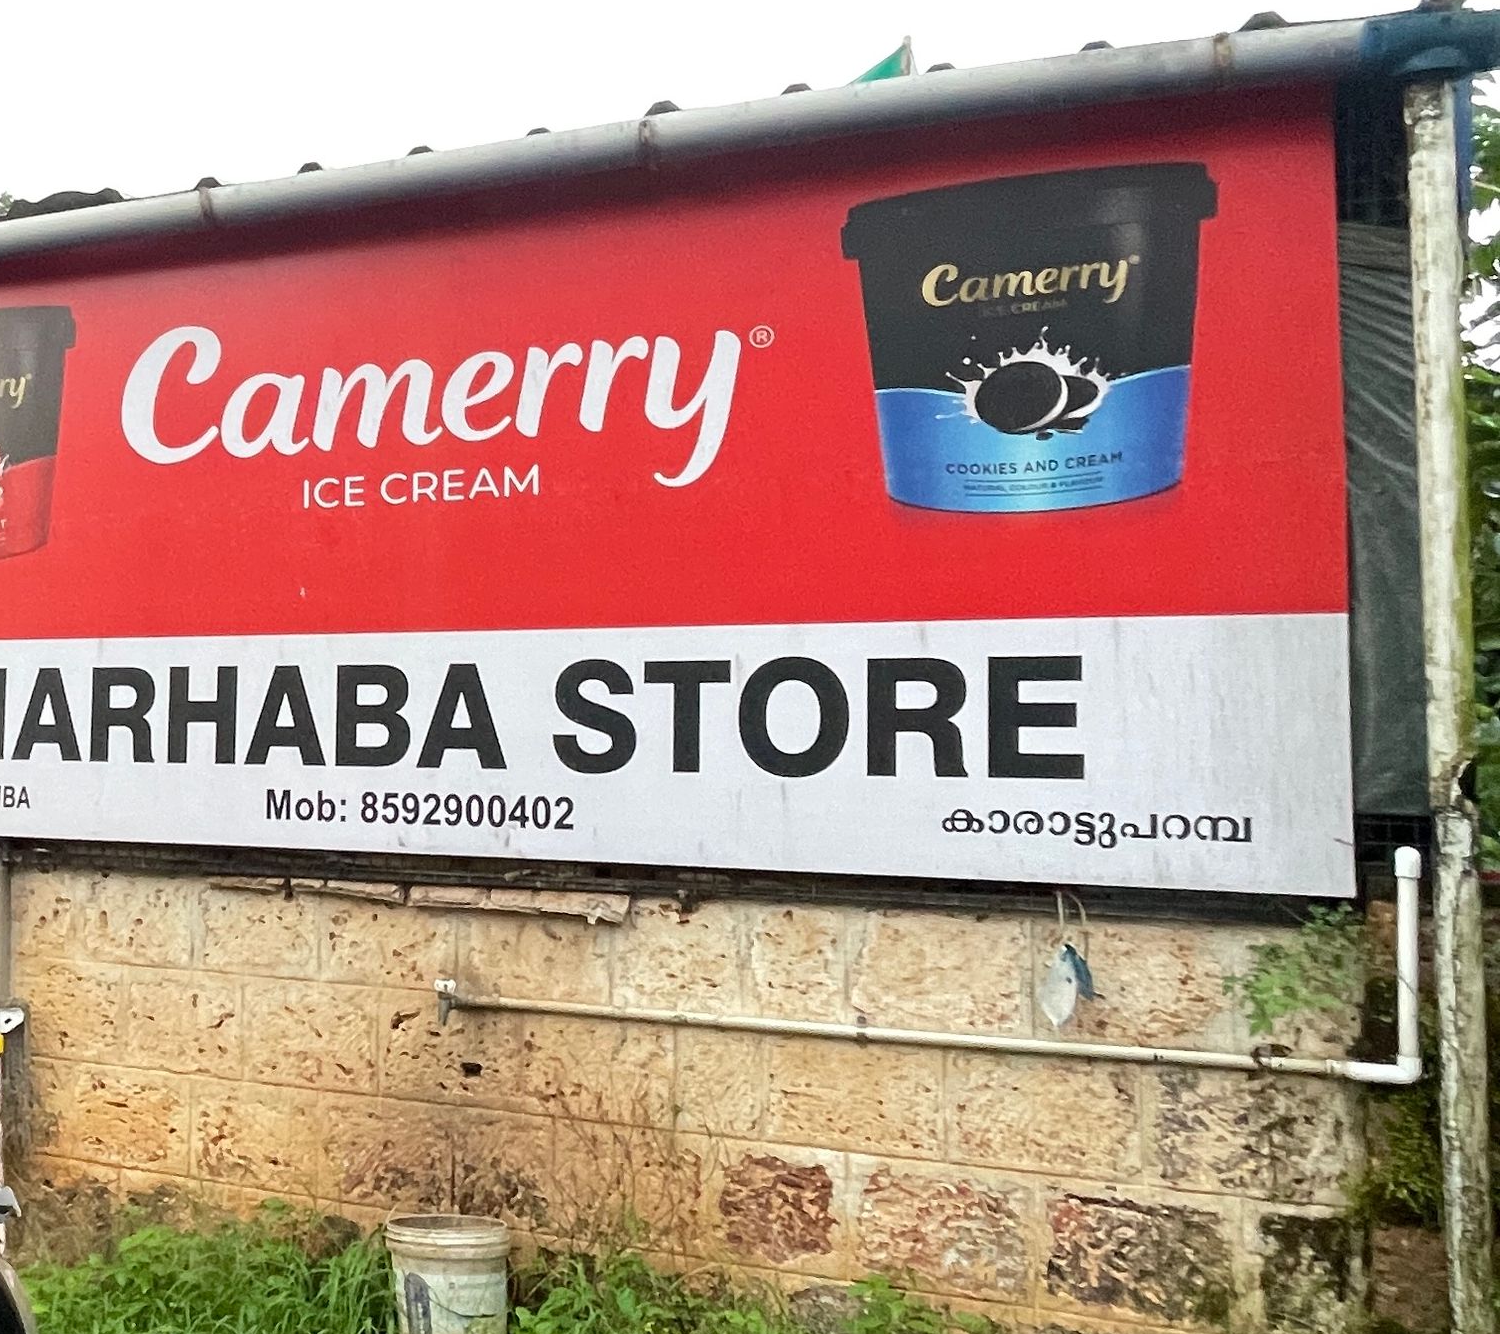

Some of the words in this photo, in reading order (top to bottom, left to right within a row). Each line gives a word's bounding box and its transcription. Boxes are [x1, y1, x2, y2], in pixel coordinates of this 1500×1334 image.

[921, 259, 1129, 307] Camerry
[122, 326, 742, 488] Camerry
[946, 462, 1017, 475] COOKIES
[1023, 459, 1059, 473] AND
[1065, 451, 1123, 469] CREAM
[304, 475, 365, 509] ICE
[381, 464, 540, 505] CREAM
[552, 655, 1085, 780] STORE
[266, 788, 347, 823] Mob:
[360, 791, 574, 830] 8592900402
[941, 808, 1253, 849] കാരാട്ടുപറമ്പ
